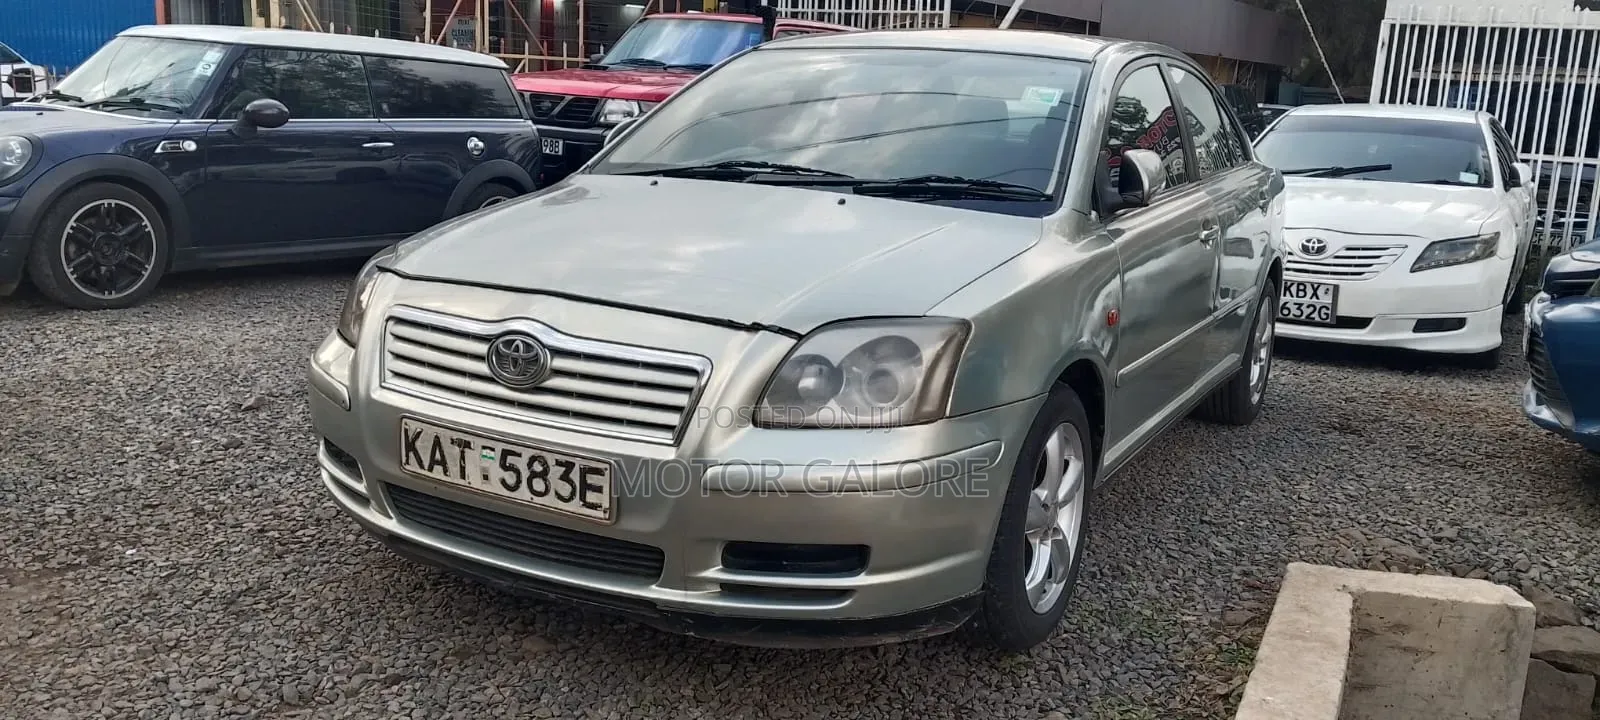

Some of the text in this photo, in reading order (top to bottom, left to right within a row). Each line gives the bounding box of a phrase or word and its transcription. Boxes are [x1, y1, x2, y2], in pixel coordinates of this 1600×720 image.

[1282, 281, 1321, 300] KBX
[1279, 301, 1330, 321] 632G
[403, 425, 607, 510] KAT 583E
